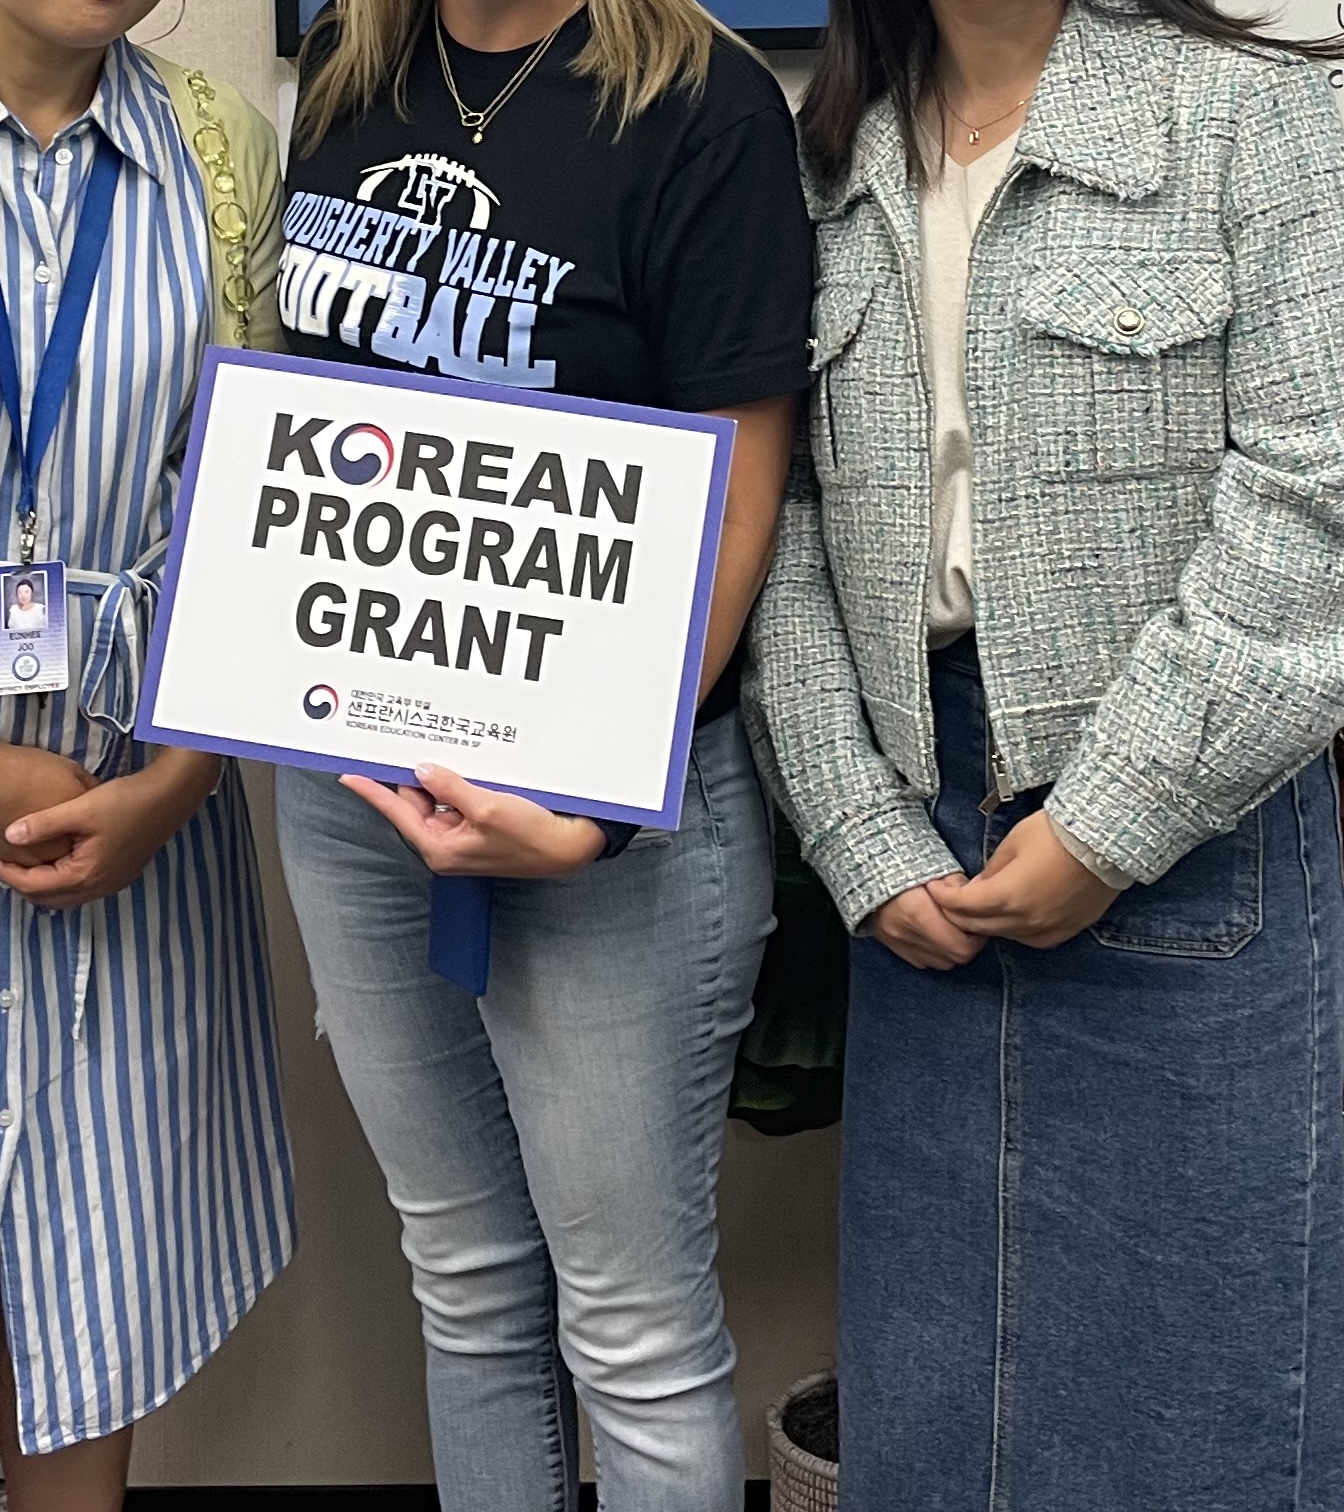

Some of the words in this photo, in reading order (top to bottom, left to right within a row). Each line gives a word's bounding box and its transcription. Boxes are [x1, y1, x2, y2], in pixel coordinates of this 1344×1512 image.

[439, 228, 576, 305] VALLEY
[265, 411, 644, 525] KOREAN
[251, 484, 634, 606] PROGRAM
[295, 580, 564, 682] GRANT
[345, 720, 378, 732] KOREAN
[380, 725, 426, 740] EDUCATION
[428, 733, 459, 746] CENTER
[347, 701, 517, 743] 샌프란시스코한국교육원
